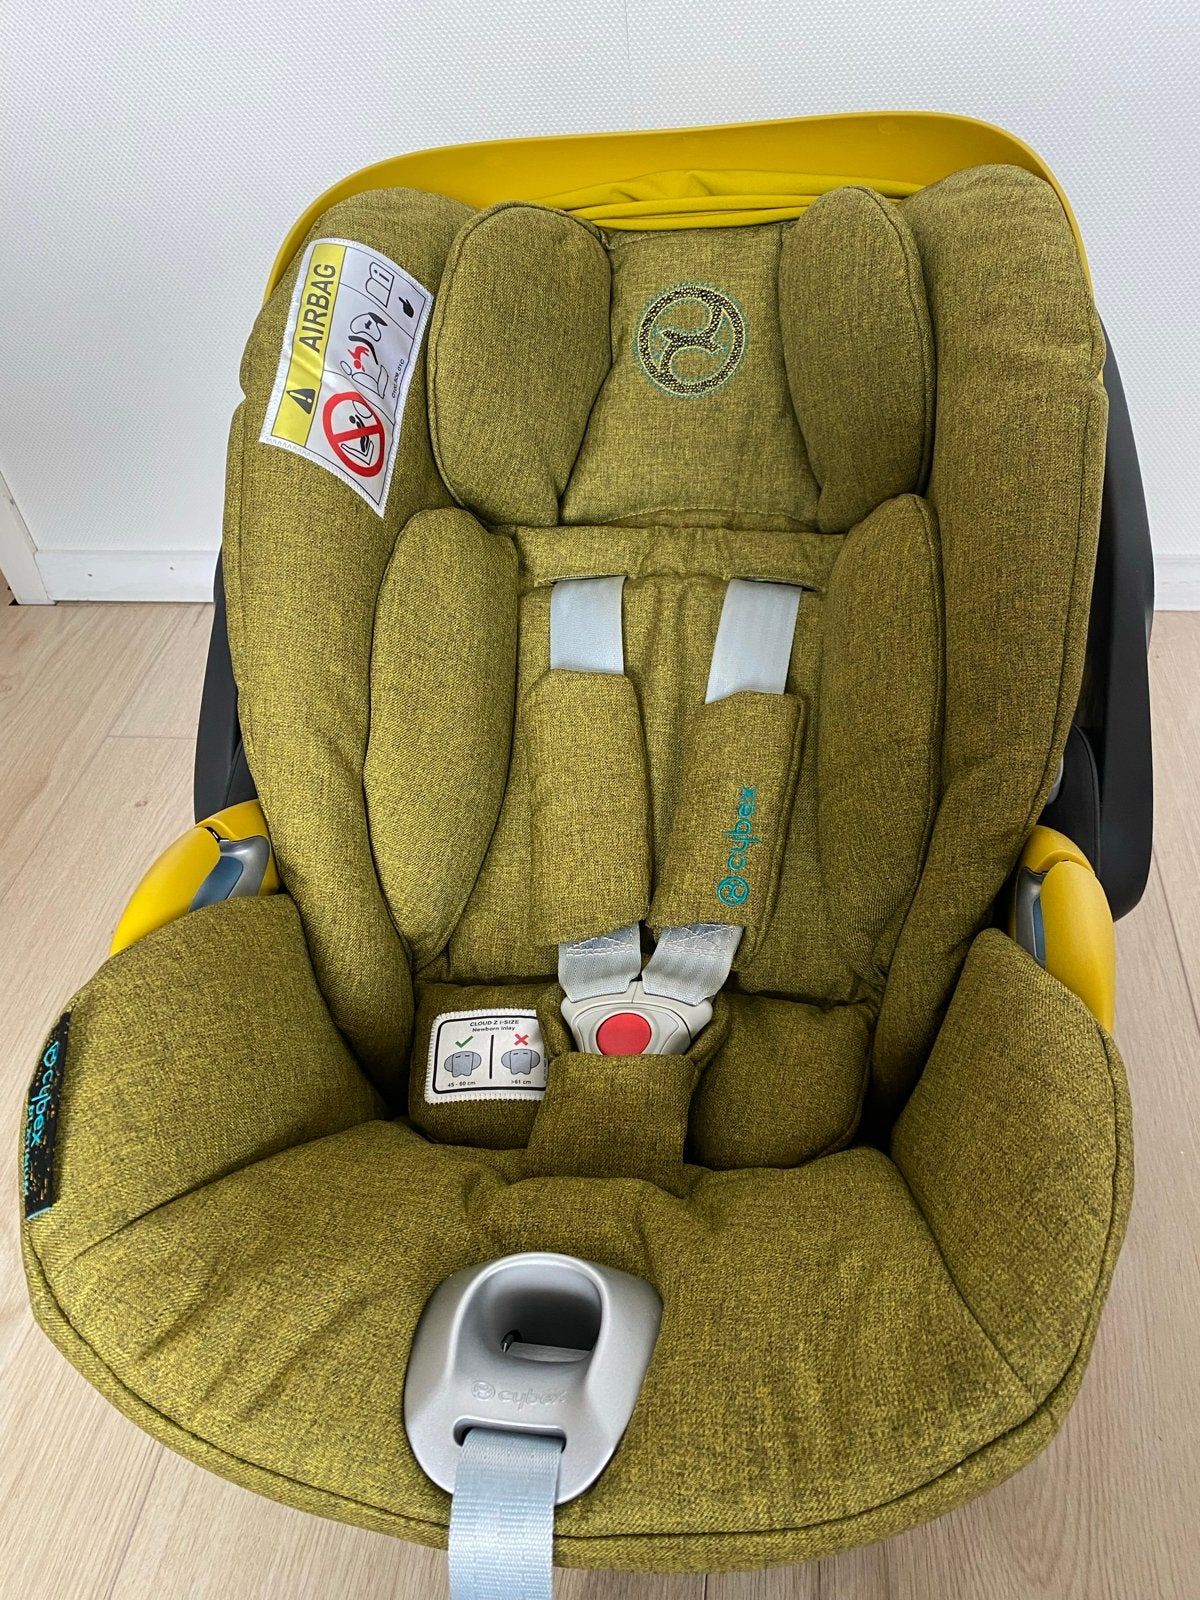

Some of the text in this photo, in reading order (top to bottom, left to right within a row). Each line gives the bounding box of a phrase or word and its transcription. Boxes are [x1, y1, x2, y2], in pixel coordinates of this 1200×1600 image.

[299, 262, 336, 353] AIRBAG
[722, 783, 762, 871] cybex
[30, 1069, 54, 1147] cybex
[498, 1388, 569, 1411] cybex
